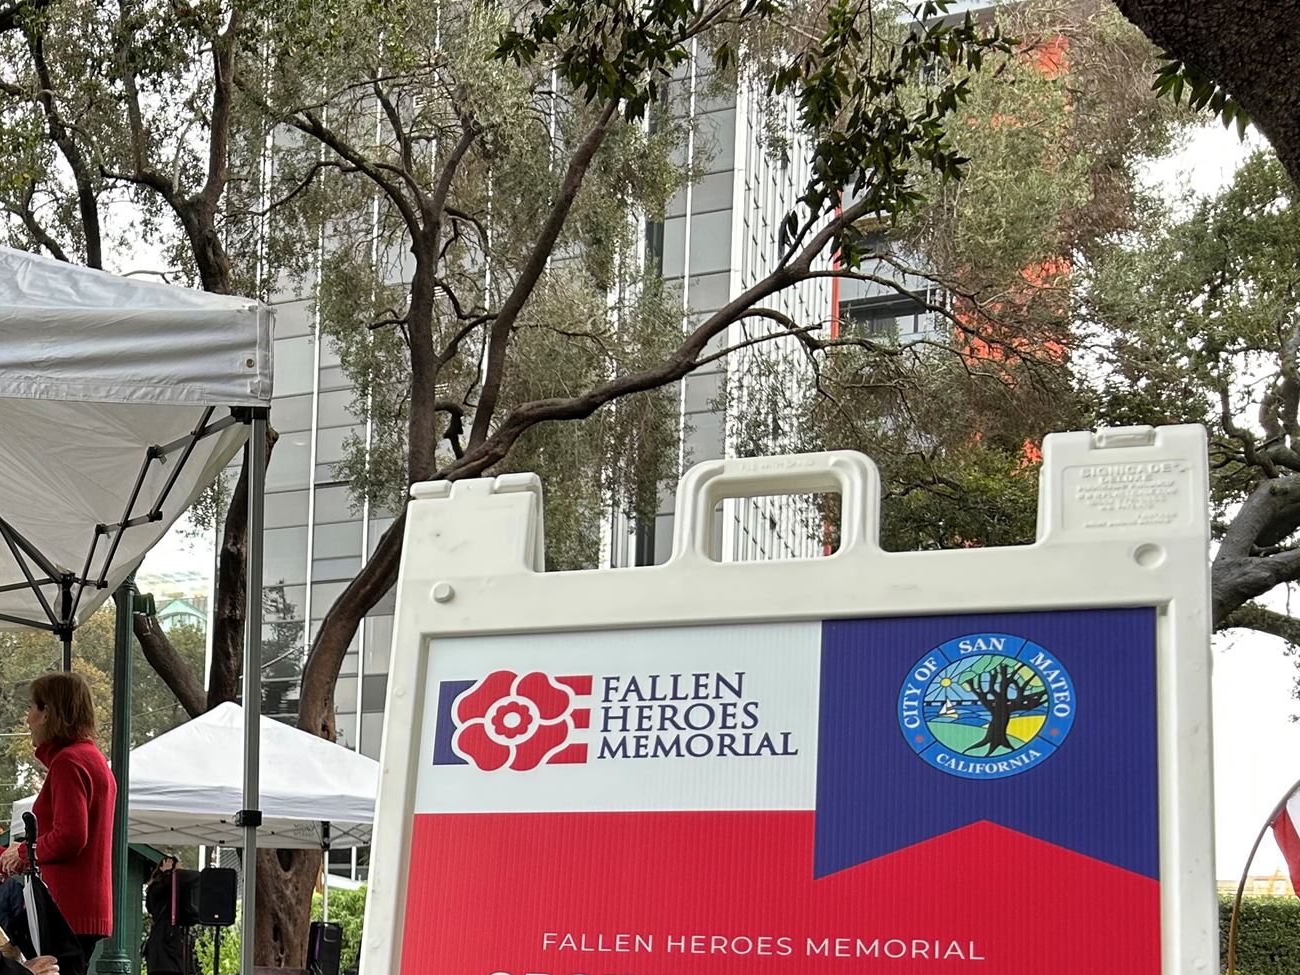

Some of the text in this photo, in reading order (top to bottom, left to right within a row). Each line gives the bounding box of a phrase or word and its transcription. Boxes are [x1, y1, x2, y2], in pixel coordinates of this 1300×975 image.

[601, 671, 747, 703] FALLEN
[902, 637, 1072, 729] CITY OF SAN MATEO
[599, 701, 760, 733] HEROES
[596, 731, 800, 760] MEMORIAL
[935, 749, 1042, 775] CALIFORNIA
[542, 932, 985, 960] FALLEN HEROES MEMORIAL
